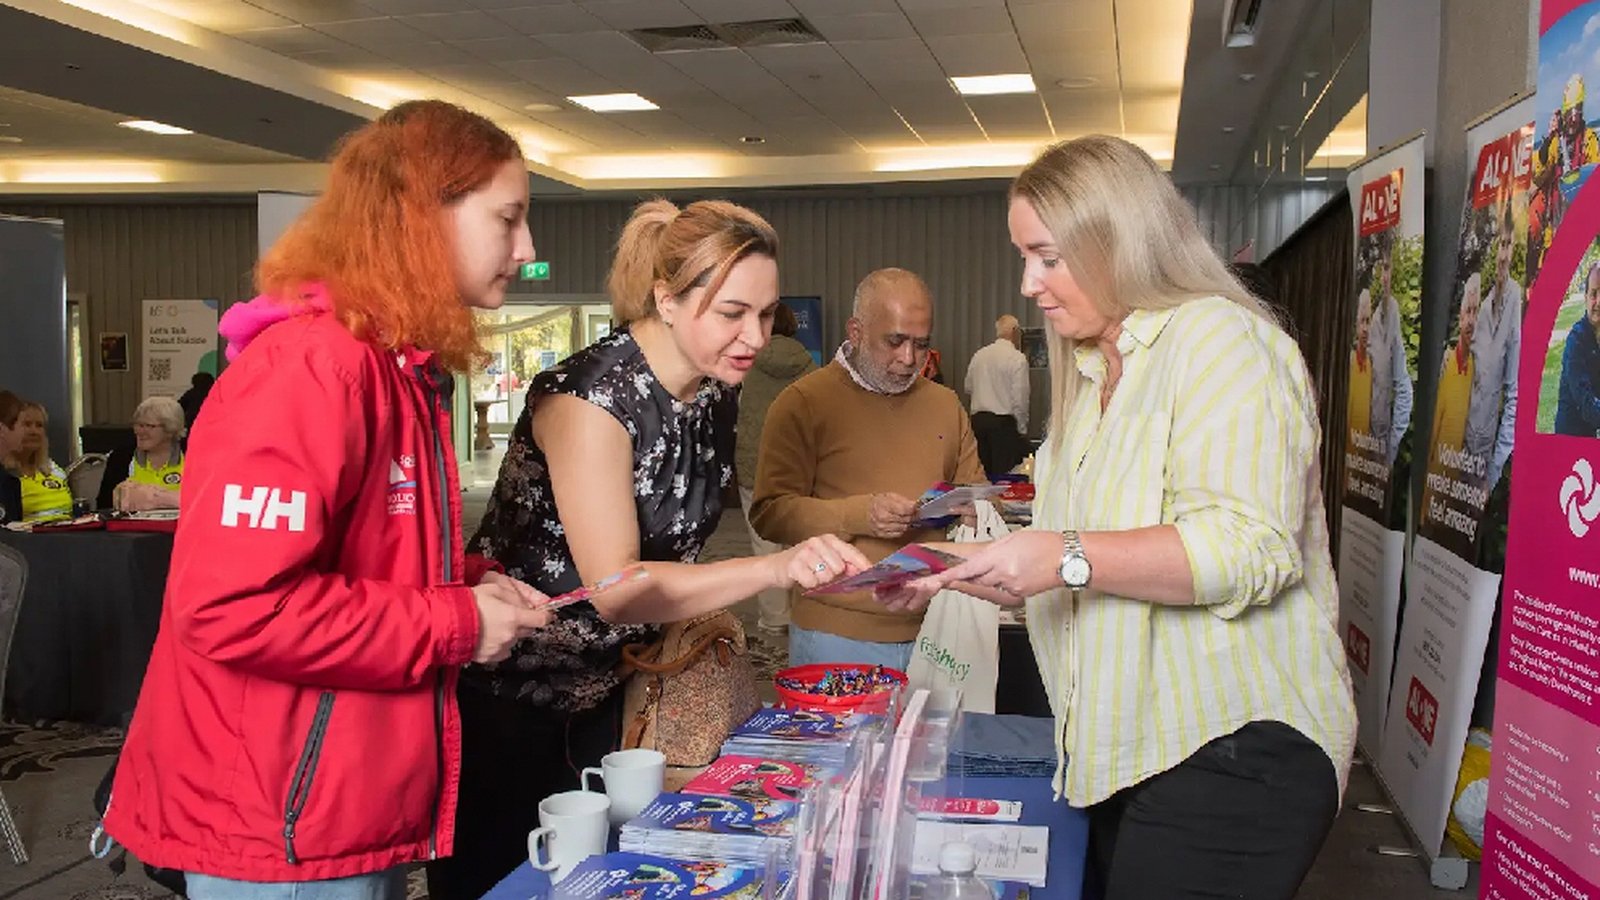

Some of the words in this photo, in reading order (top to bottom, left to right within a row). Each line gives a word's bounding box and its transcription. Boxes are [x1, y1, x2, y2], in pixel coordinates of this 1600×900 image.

[149, 326, 168, 335] Let's
[171, 326, 187, 335] Talk
[149, 336, 175, 345] About
[1438, 442, 1475, 474] Volunteer
[221, 483, 306, 532] HH
[1427, 470, 1451, 495] make
[1450, 479, 1486, 511] someone
[1429, 495, 1446, 522] feel
[1444, 507, 1478, 543] amazing
